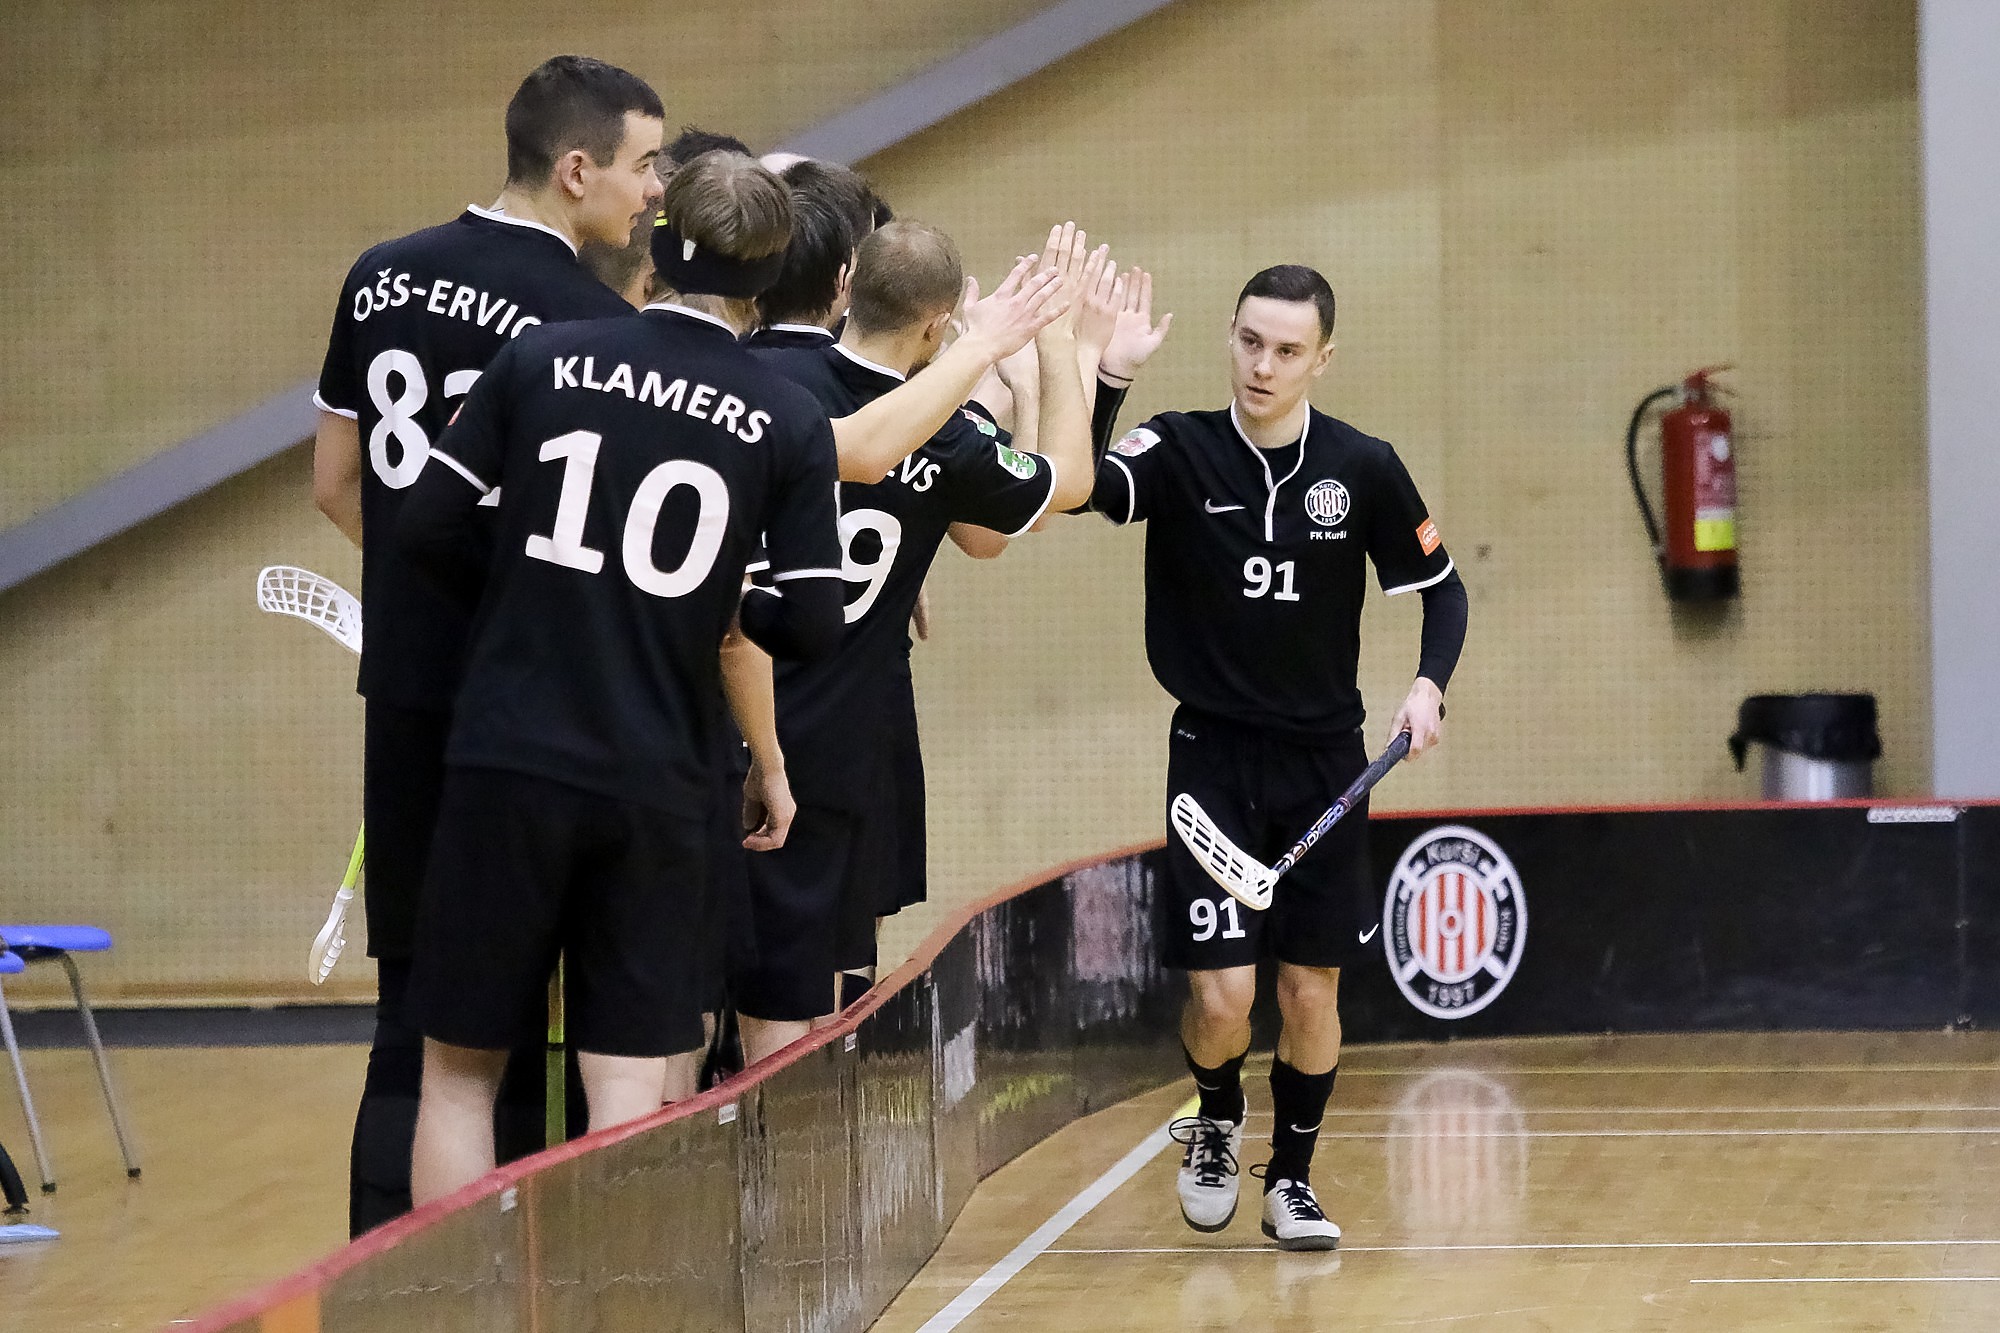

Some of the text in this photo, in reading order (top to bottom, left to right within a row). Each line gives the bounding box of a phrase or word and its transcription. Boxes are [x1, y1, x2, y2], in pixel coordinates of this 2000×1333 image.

[553, 356, 773, 445] KLAMERS
[886, 452, 942, 493] VS
[525, 430, 730, 598] 10
[1310, 531, 1323, 540] FK
[1243, 556, 1300, 601] 91
[1189, 897, 1246, 942] 91
